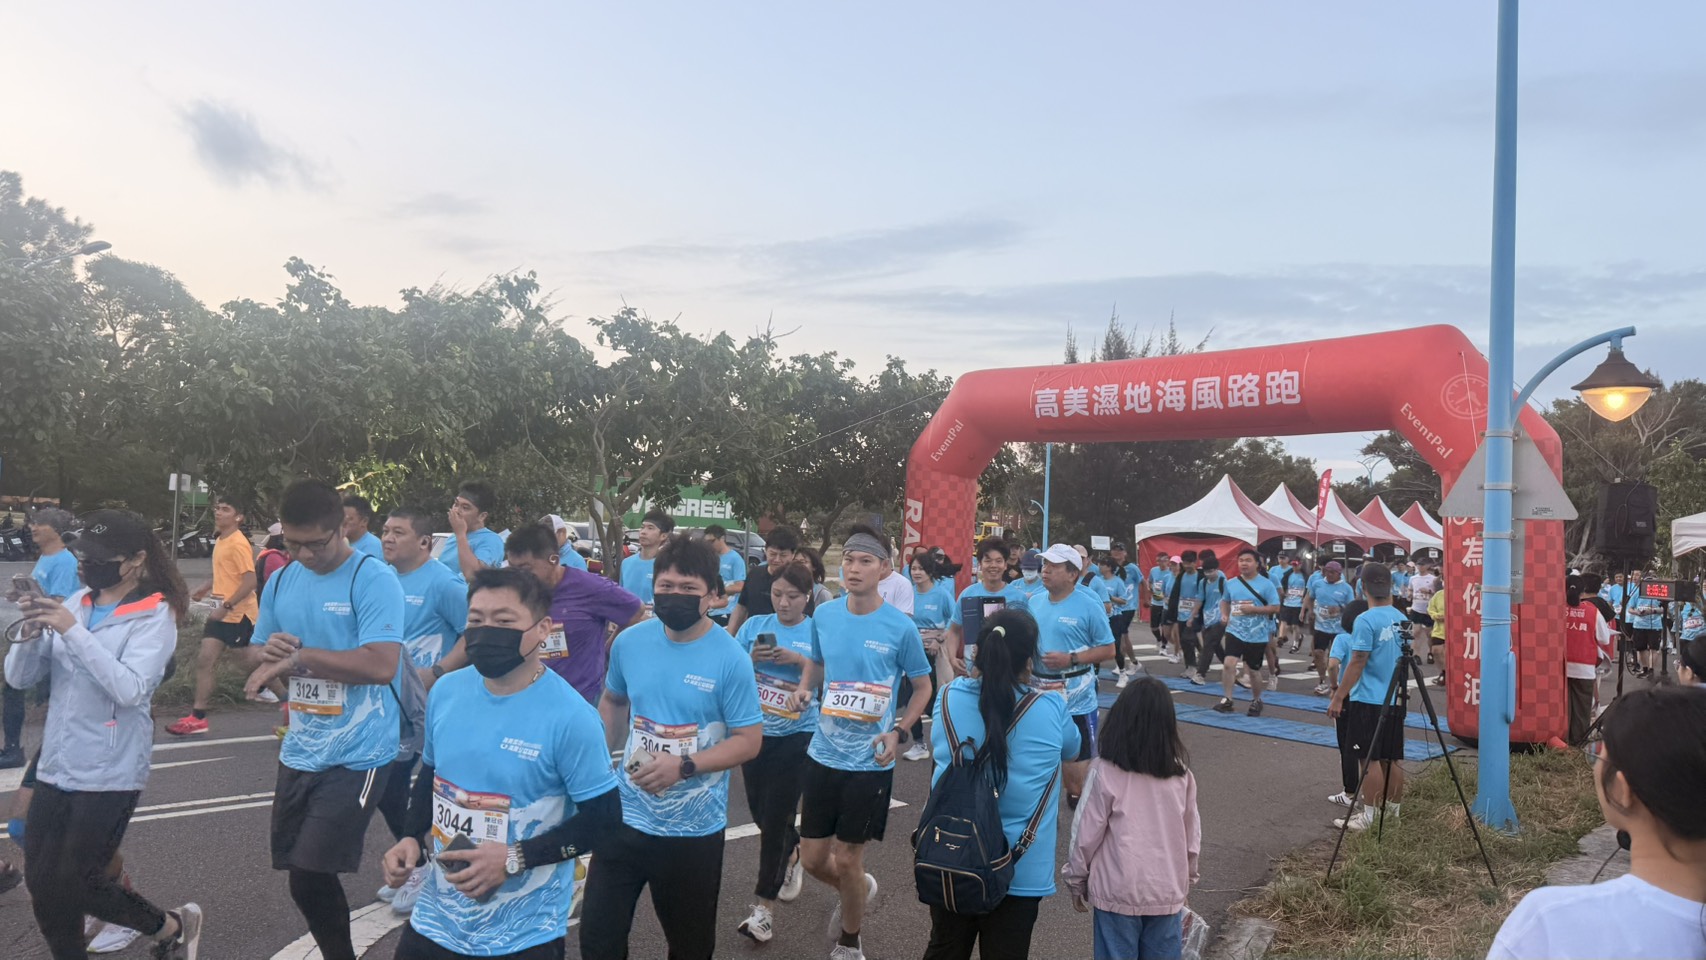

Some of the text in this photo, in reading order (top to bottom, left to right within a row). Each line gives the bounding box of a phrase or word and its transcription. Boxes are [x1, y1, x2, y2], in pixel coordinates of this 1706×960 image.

[1034, 368, 1301, 419] 高美濕地海風路跑
[930, 419, 964, 462] EventPal
[1400, 402, 1454, 459] EventPal
[296, 682, 319, 700] 3124
[757, 687, 785, 705] 5075
[832, 694, 867, 710] 3071
[437, 803, 474, 837] 3044
